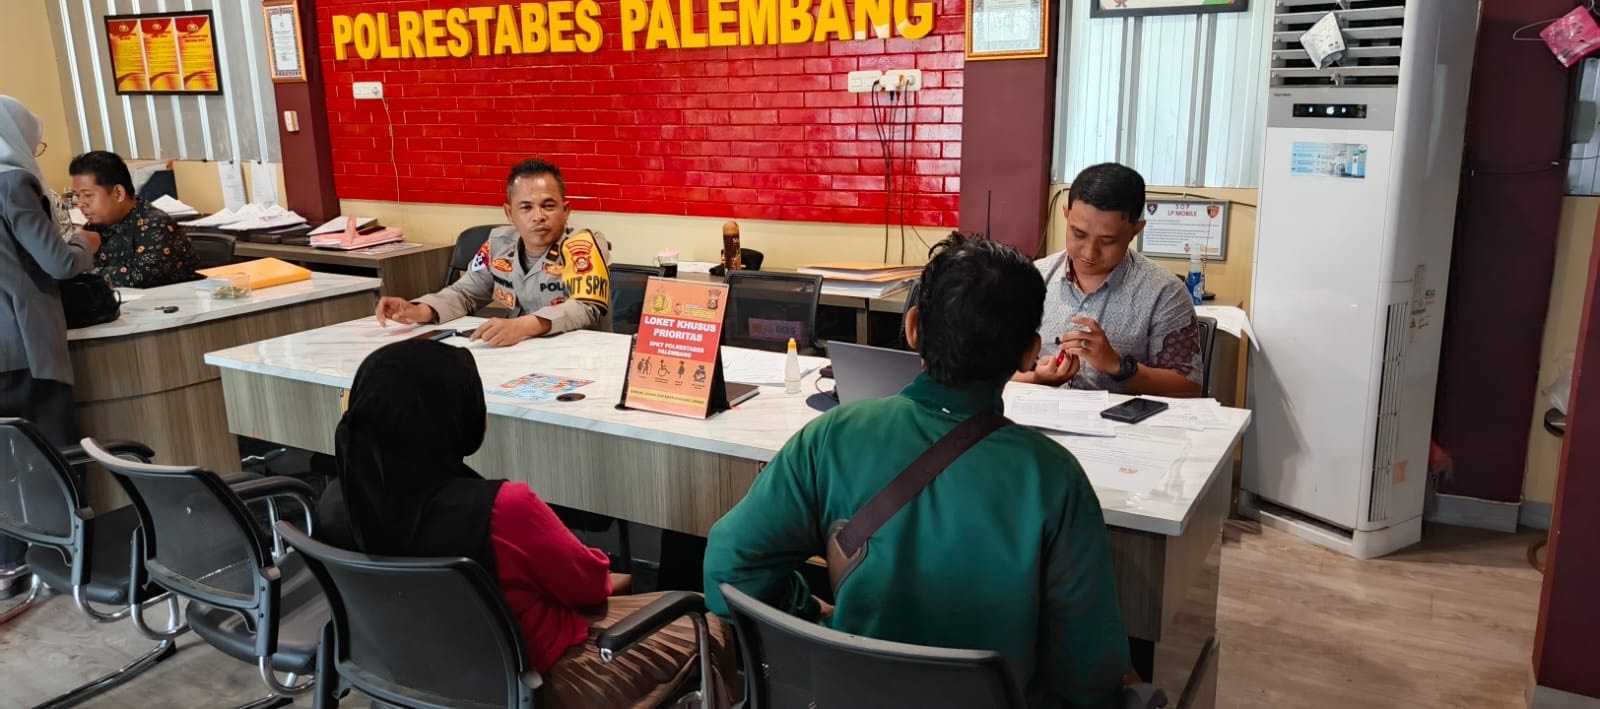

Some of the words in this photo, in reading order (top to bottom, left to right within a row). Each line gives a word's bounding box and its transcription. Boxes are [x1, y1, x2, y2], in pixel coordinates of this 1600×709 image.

[332, 0, 602, 60] POLRESTABES
[621, 0, 935, 51] PALEMBANG
[540, 281, 564, 292] POL
[586, 275, 608, 301] SPKT
[644, 316, 675, 327] LOKET
[677, 320, 716, 332] KHUSUS
[653, 328, 703, 342] PRIORITAS
